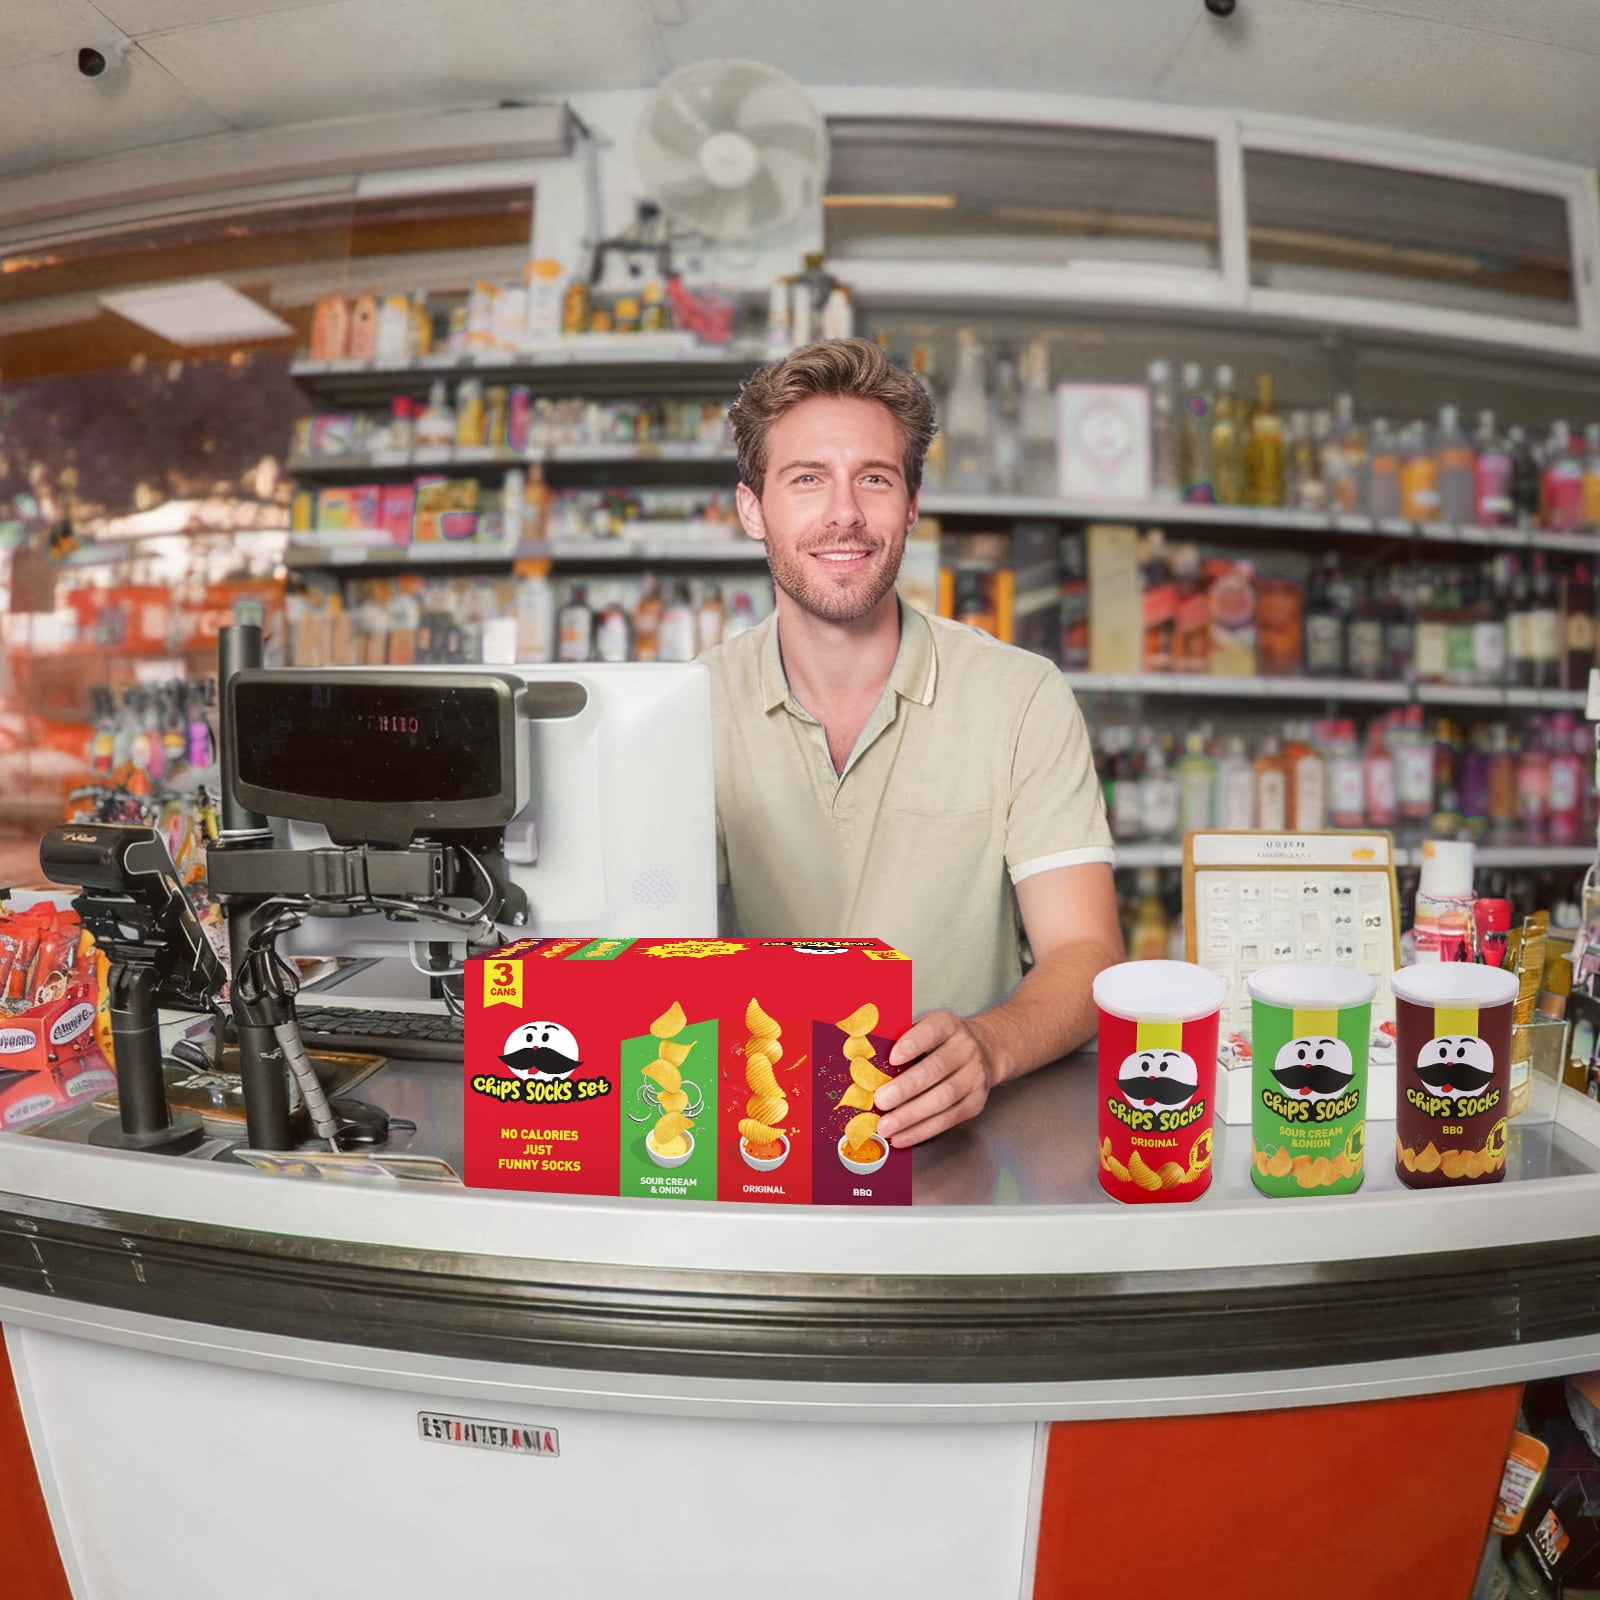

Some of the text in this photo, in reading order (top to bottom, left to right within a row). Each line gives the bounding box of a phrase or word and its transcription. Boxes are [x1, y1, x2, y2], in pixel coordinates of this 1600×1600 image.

[492, 962, 514, 987] 3
[490, 987, 516, 996] CANS
[501, 1128, 579, 1141] NO CALORIES
[1279, 1126, 1343, 1139] SOUR CREAM
[1442, 1125, 1463, 1135] BBQ
[1130, 1136, 1179, 1148] ORIGINAL
[1291, 1138, 1331, 1149] &ONION
[522, 1144, 553, 1155] JUST
[498, 1158, 581, 1172] FUNNY SOCKS
[640, 1176, 698, 1187] SOUR CREAM
[650, 1185, 687, 1195] & ONION
[742, 1184, 786, 1194] ORIGINAL
[853, 1187, 873, 1197] BBQ
